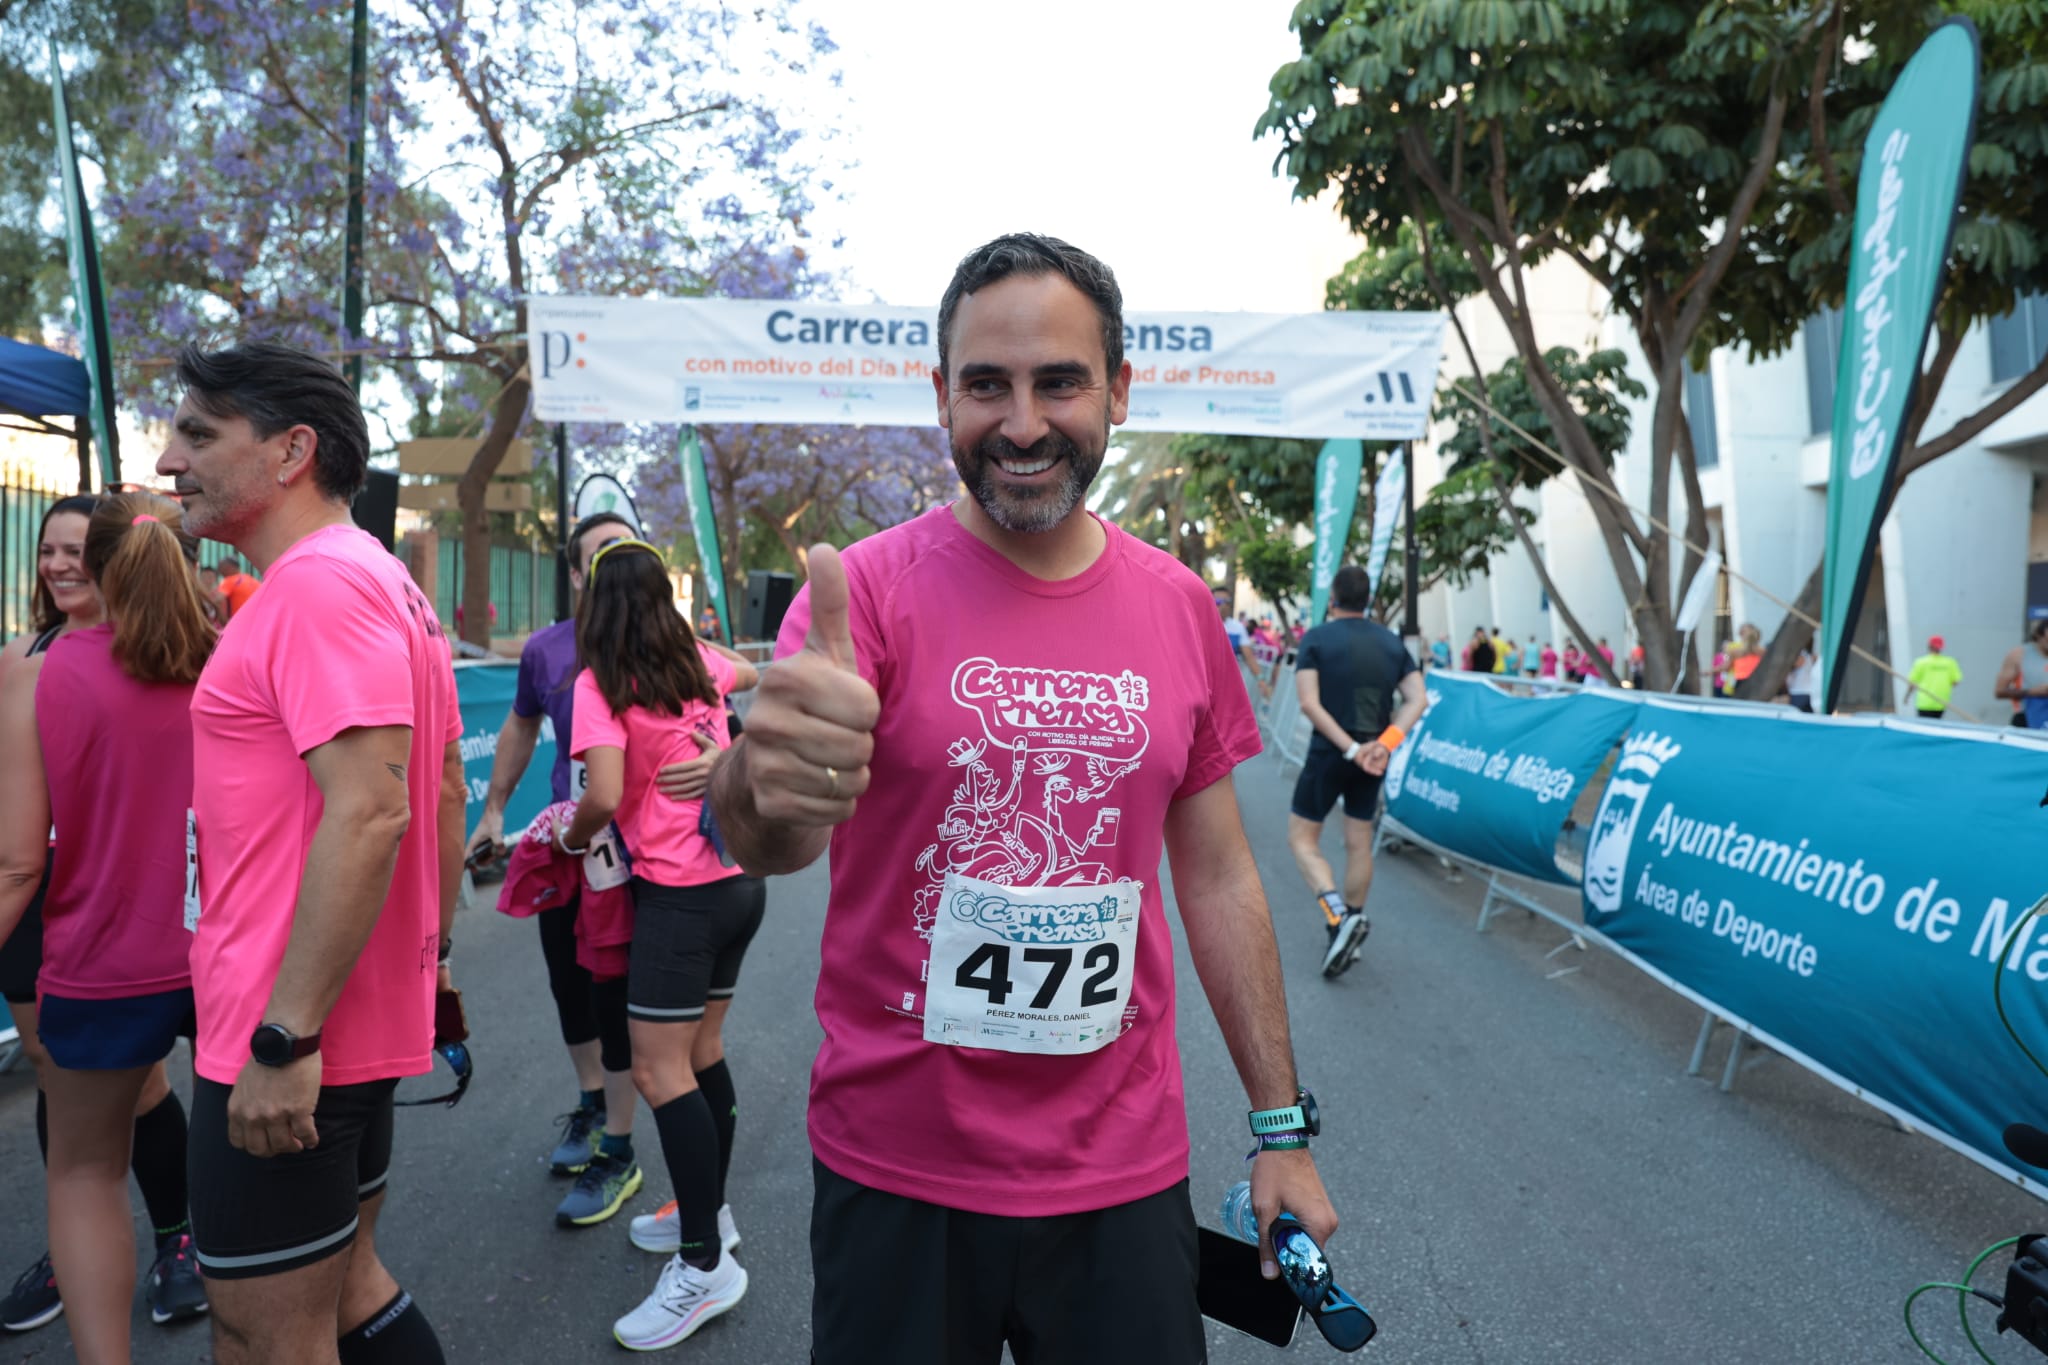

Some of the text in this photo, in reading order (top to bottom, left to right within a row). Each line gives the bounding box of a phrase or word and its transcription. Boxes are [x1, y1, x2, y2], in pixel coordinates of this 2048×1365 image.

[766, 309, 1213, 352] Carrera ensa
[685, 358, 725, 374] con
[733, 356, 811, 376] motivo
[819, 359, 854, 376] del
[860, 359, 896, 377] Día
[904, 360, 932, 378] Mu
[1164, 366, 1191, 384] de
[1198, 366, 1275, 386] Prensa
[964, 665, 1143, 703] Carrera de
[1125, 688, 1146, 707] la
[994, 698, 1129, 733] Prensa
[1042, 731, 1064, 739] MOTIVO
[1415, 730, 1575, 804] Ayuntamiento de Málaga
[1647, 801, 1884, 917] Ayuntamiento
[1894, 876, 1961, 944] de
[980, 901, 1100, 924] Carrera
[1635, 864, 1819, 979] Área de Deporte
[1002, 920, 1104, 942] Prensa
[955, 942, 1119, 1009] 472
[986, 1008, 1091, 1022] PÉREZ MORALES, DANIEL
[1264, 1134, 1299, 1144] Nuestra
